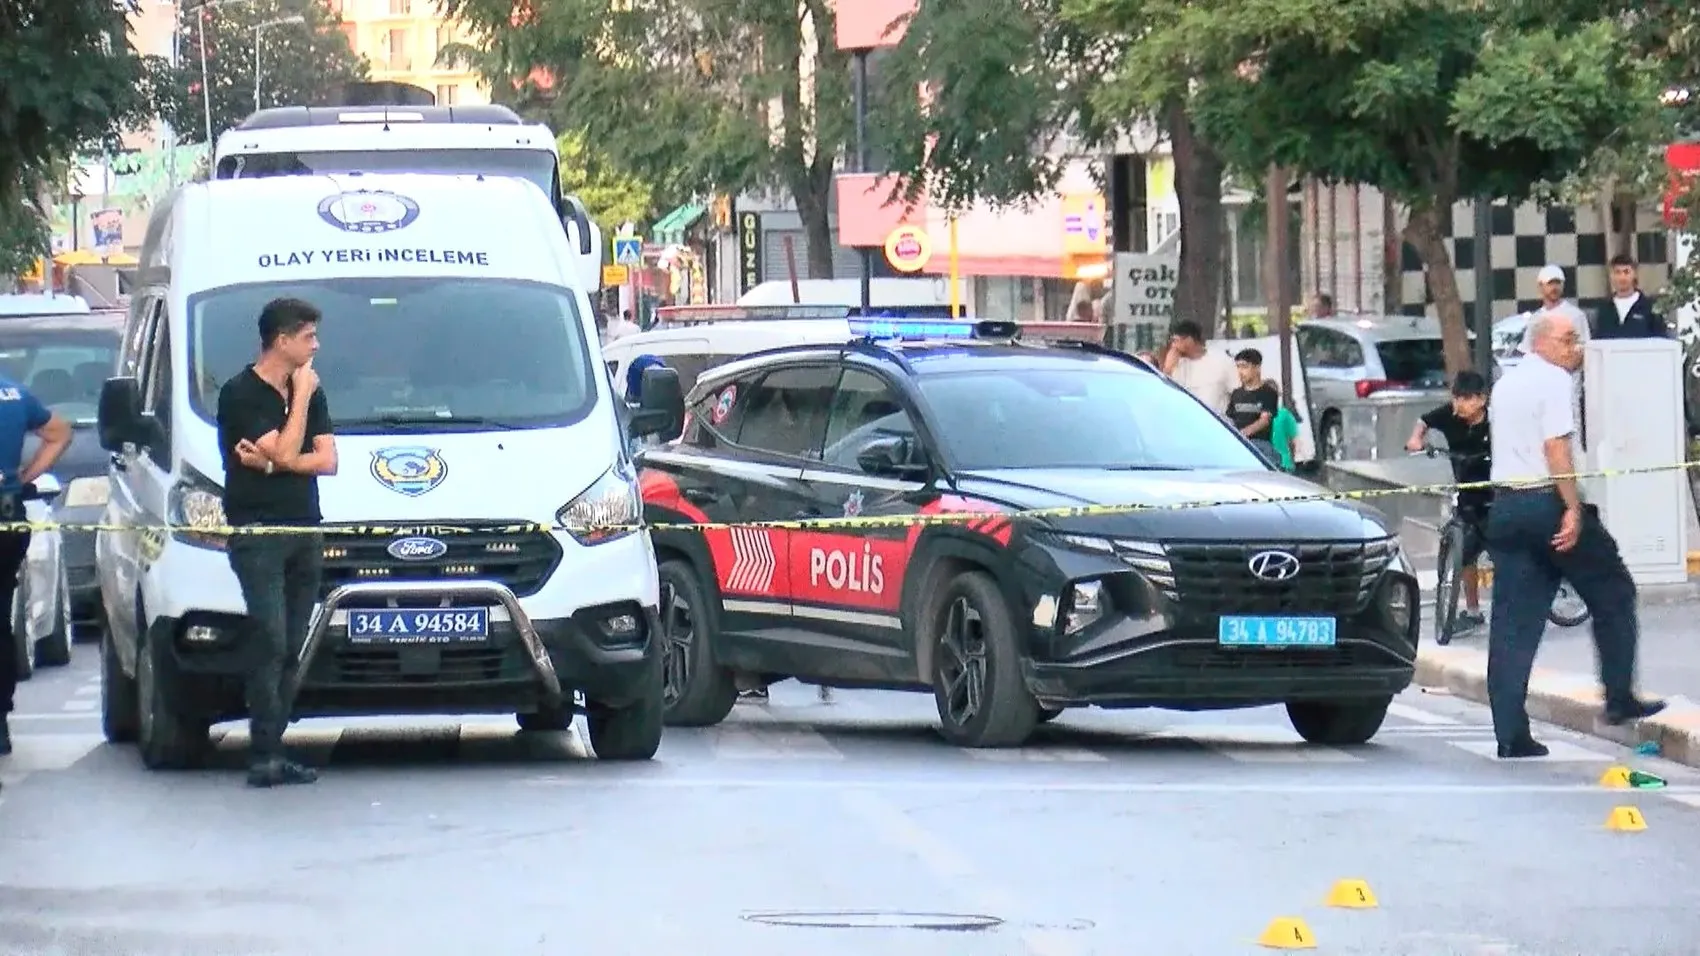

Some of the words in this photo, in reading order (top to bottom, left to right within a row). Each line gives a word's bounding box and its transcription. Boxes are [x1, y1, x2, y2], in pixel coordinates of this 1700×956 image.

[258, 250, 315, 268] OLAY
[399, 540, 434, 556] Ford
[811, 541, 884, 594] POLİS
[356, 613, 383, 633] 34
[388, 613, 409, 633] A
[415, 613, 481, 633] 94584
[1228, 619, 1249, 641] 34
[1258, 620, 1267, 641] A
[1276, 620, 1330, 642] 94783
[1628, 810, 1636, 825] 2
[1356, 887, 1367, 902] 3
[1294, 926, 1304, 942] 4
